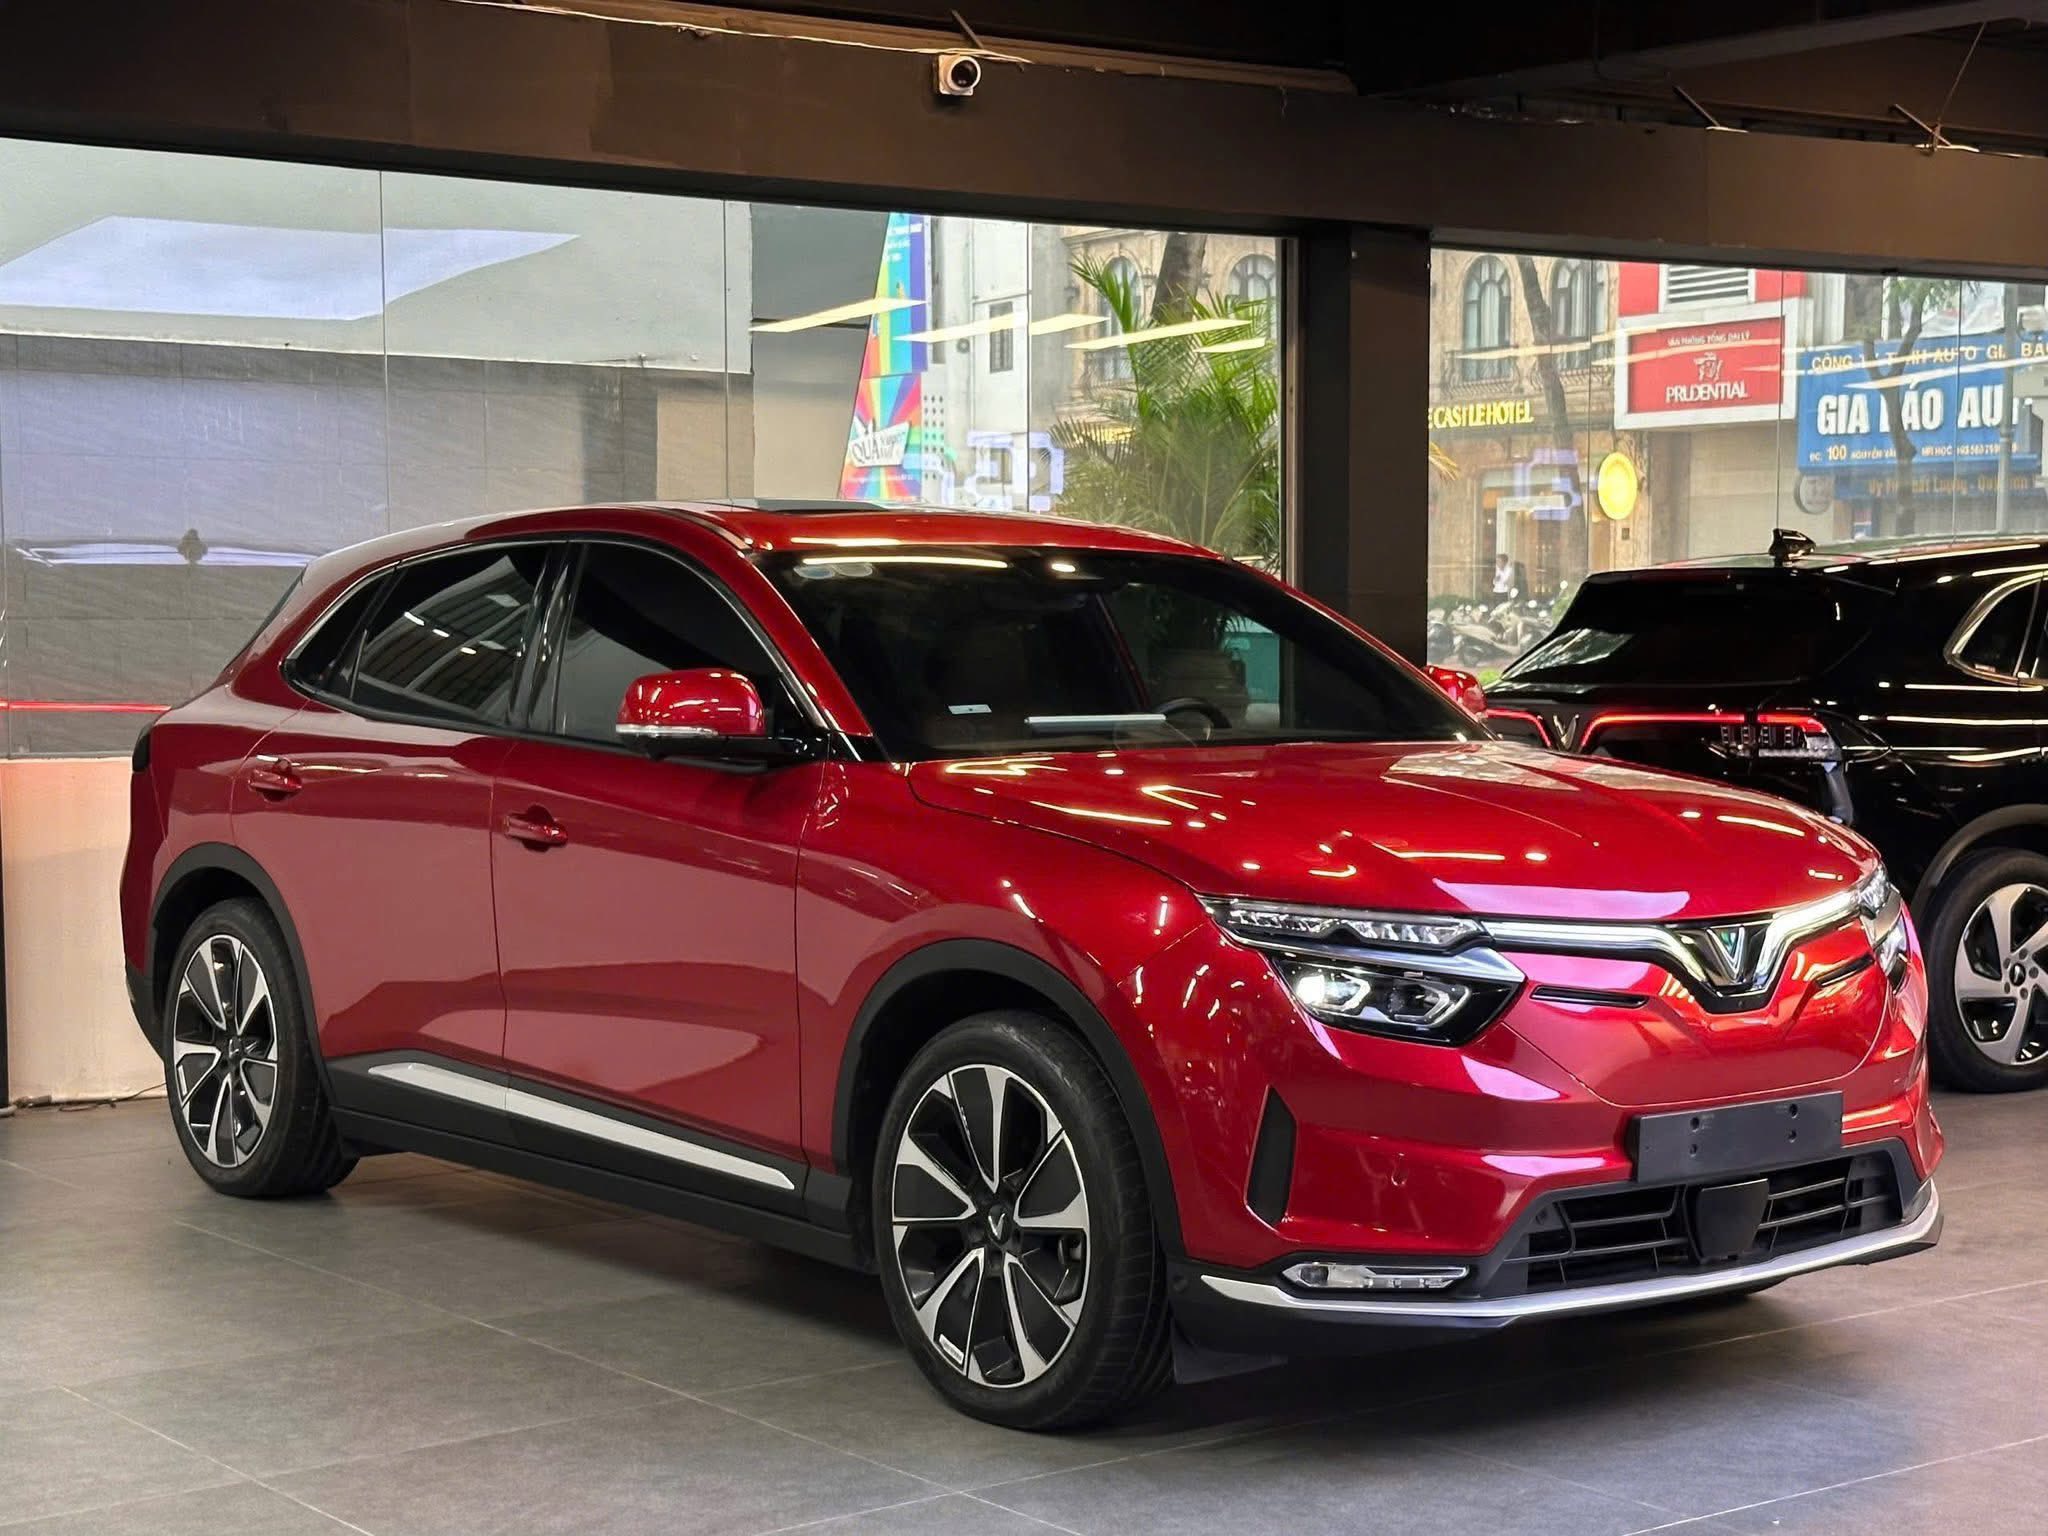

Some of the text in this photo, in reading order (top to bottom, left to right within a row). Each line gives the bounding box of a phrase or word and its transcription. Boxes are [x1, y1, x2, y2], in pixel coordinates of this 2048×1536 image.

[1665, 380, 1749, 404] PRUDENTIAL
[1816, 393, 1870, 436] GIA
[1827, 444, 1847, 461] 100
